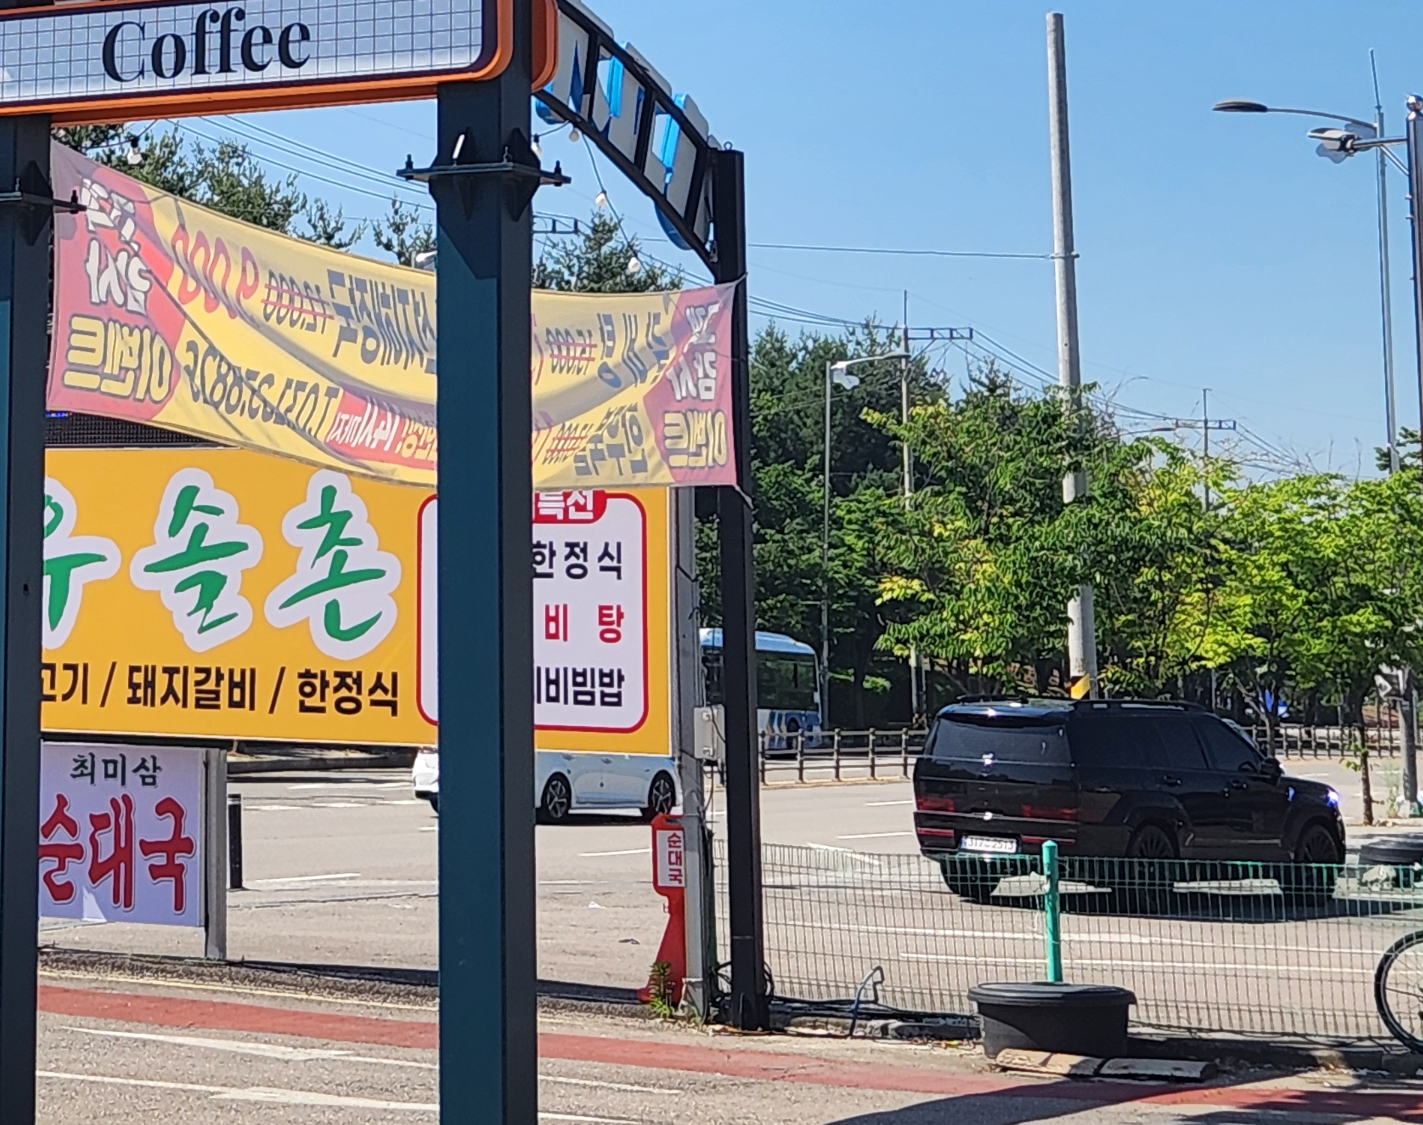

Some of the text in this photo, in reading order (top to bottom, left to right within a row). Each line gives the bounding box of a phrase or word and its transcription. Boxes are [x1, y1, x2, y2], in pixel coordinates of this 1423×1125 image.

[101, 6, 312, 84] Coffee
[533, 540, 623, 581] 한정식
[126, 664, 258, 712] 돼지갈비
[297, 668, 400, 717] 한정식
[69, 751, 164, 787] 최미삼
[39, 792, 196, 914] 순대국
